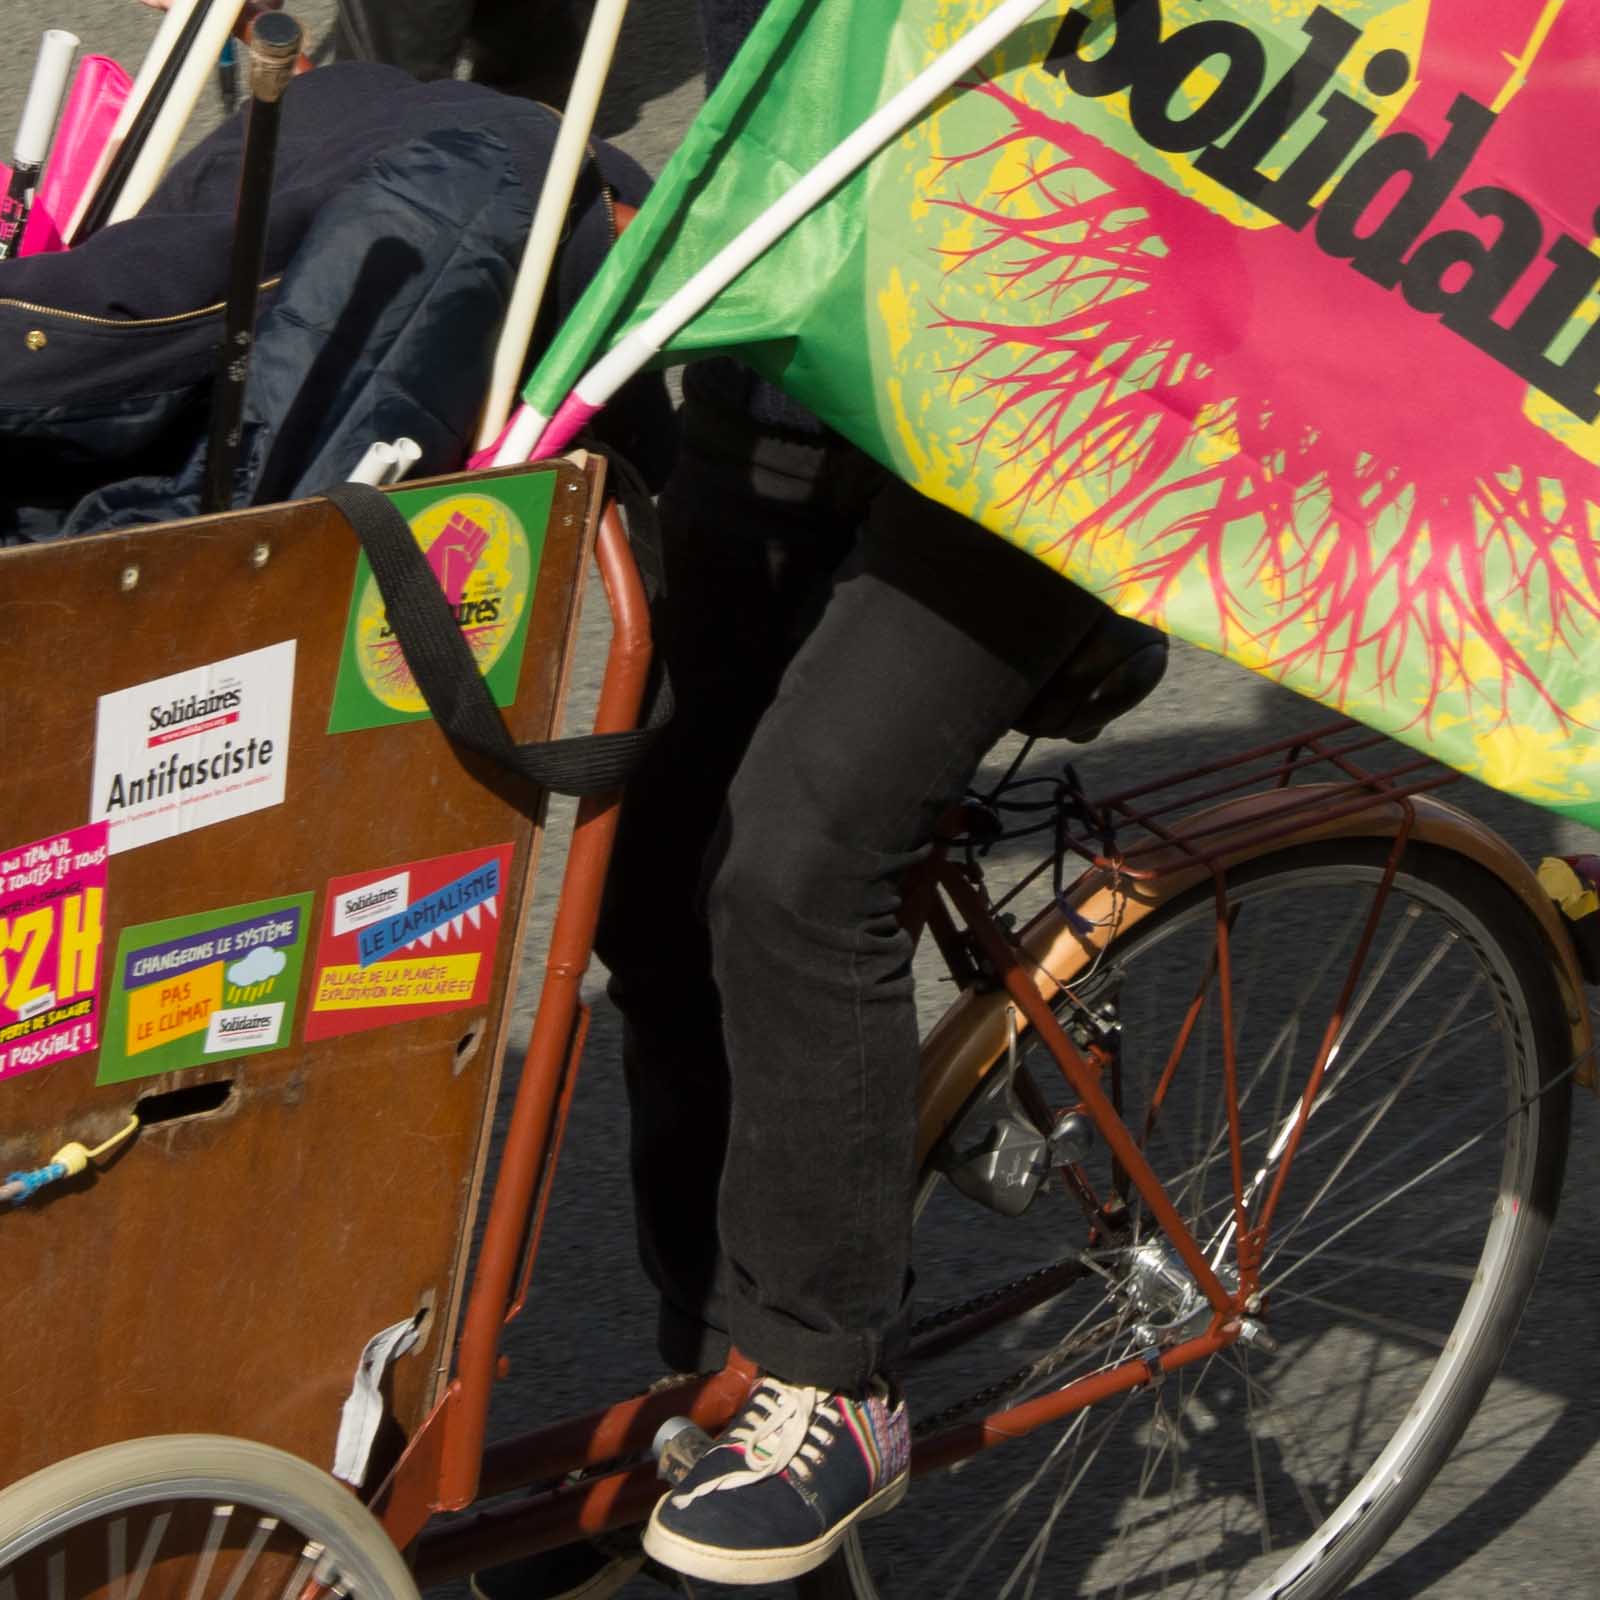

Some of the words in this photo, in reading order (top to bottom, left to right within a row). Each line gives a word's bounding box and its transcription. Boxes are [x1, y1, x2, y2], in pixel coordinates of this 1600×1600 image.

[149, 688, 242, 731] Solidaires
[106, 738, 273, 812] Antifasciste
[8, 863, 52, 891] TOUTES
[55, 857, 71, 879] ET
[74, 846, 107, 869] TOUS
[23, 838, 72, 867] TRAVAIL
[344, 886, 399, 914] Solidaires
[362, 930, 385, 958] LE
[391, 869, 497, 945] CAPITALISME
[132, 941, 214, 977] CHANGEONS
[216, 937, 232, 955] LE
[235, 919, 294, 951] SYSTÈME
[160, 981, 192, 1008] PAS
[369, 969, 384, 984] DE
[385, 968, 400, 982] LA
[391, 983, 411, 997] DES
[136, 1022, 154, 1040] LE
[159, 998, 212, 1032] CLIMAT
[218, 1014, 273, 1033] Solidaires
[9, 1025, 82, 1067] POSSIBLE
